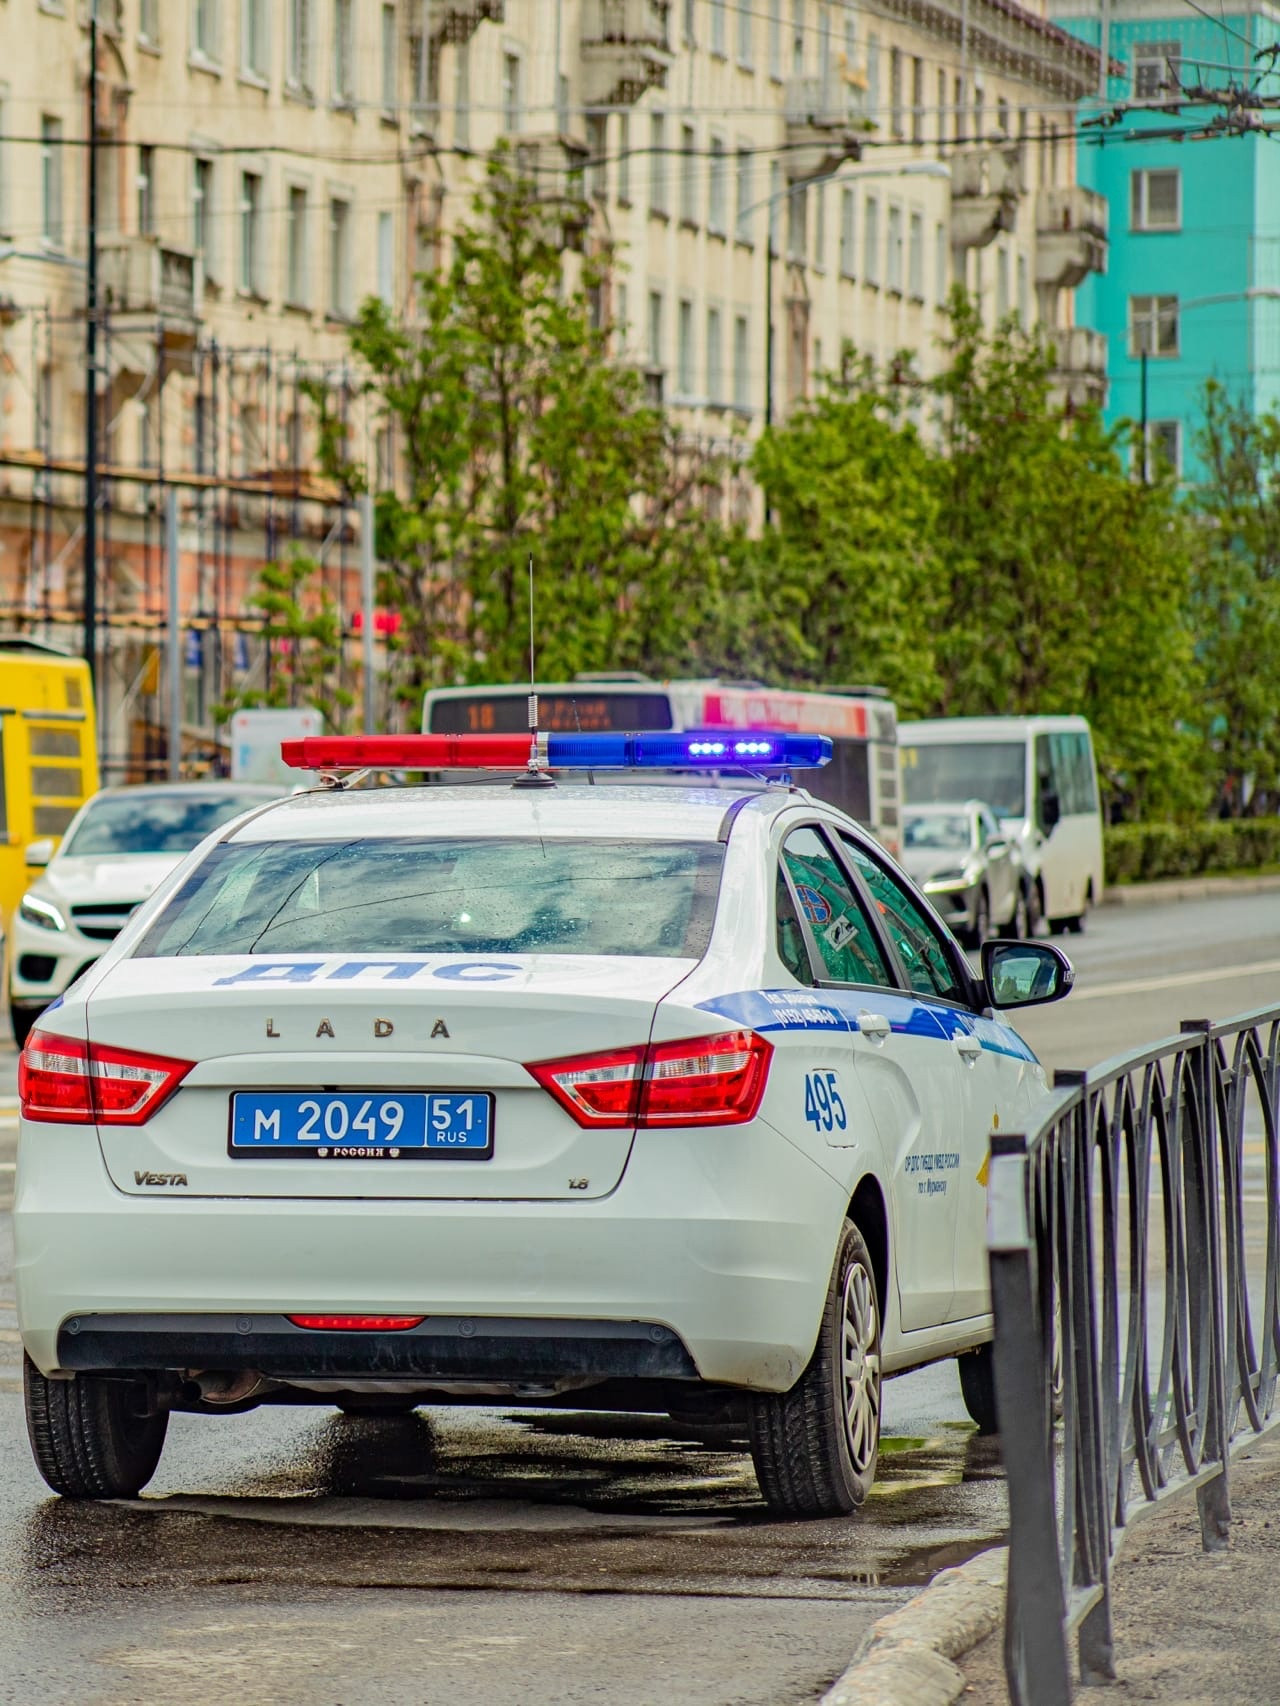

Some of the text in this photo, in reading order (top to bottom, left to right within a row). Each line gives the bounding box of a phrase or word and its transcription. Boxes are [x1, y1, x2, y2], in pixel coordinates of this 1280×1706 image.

[212, 962, 523, 986] ДПС
[266, 1018, 450, 1038] LADA
[805, 1073, 846, 1132] 495
[297, 1100, 404, 1141] 2049
[432, 1099, 473, 1130] 51
[437, 1131, 468, 1143] RUS
[333, 1147, 385, 1157] РОССИЯ
